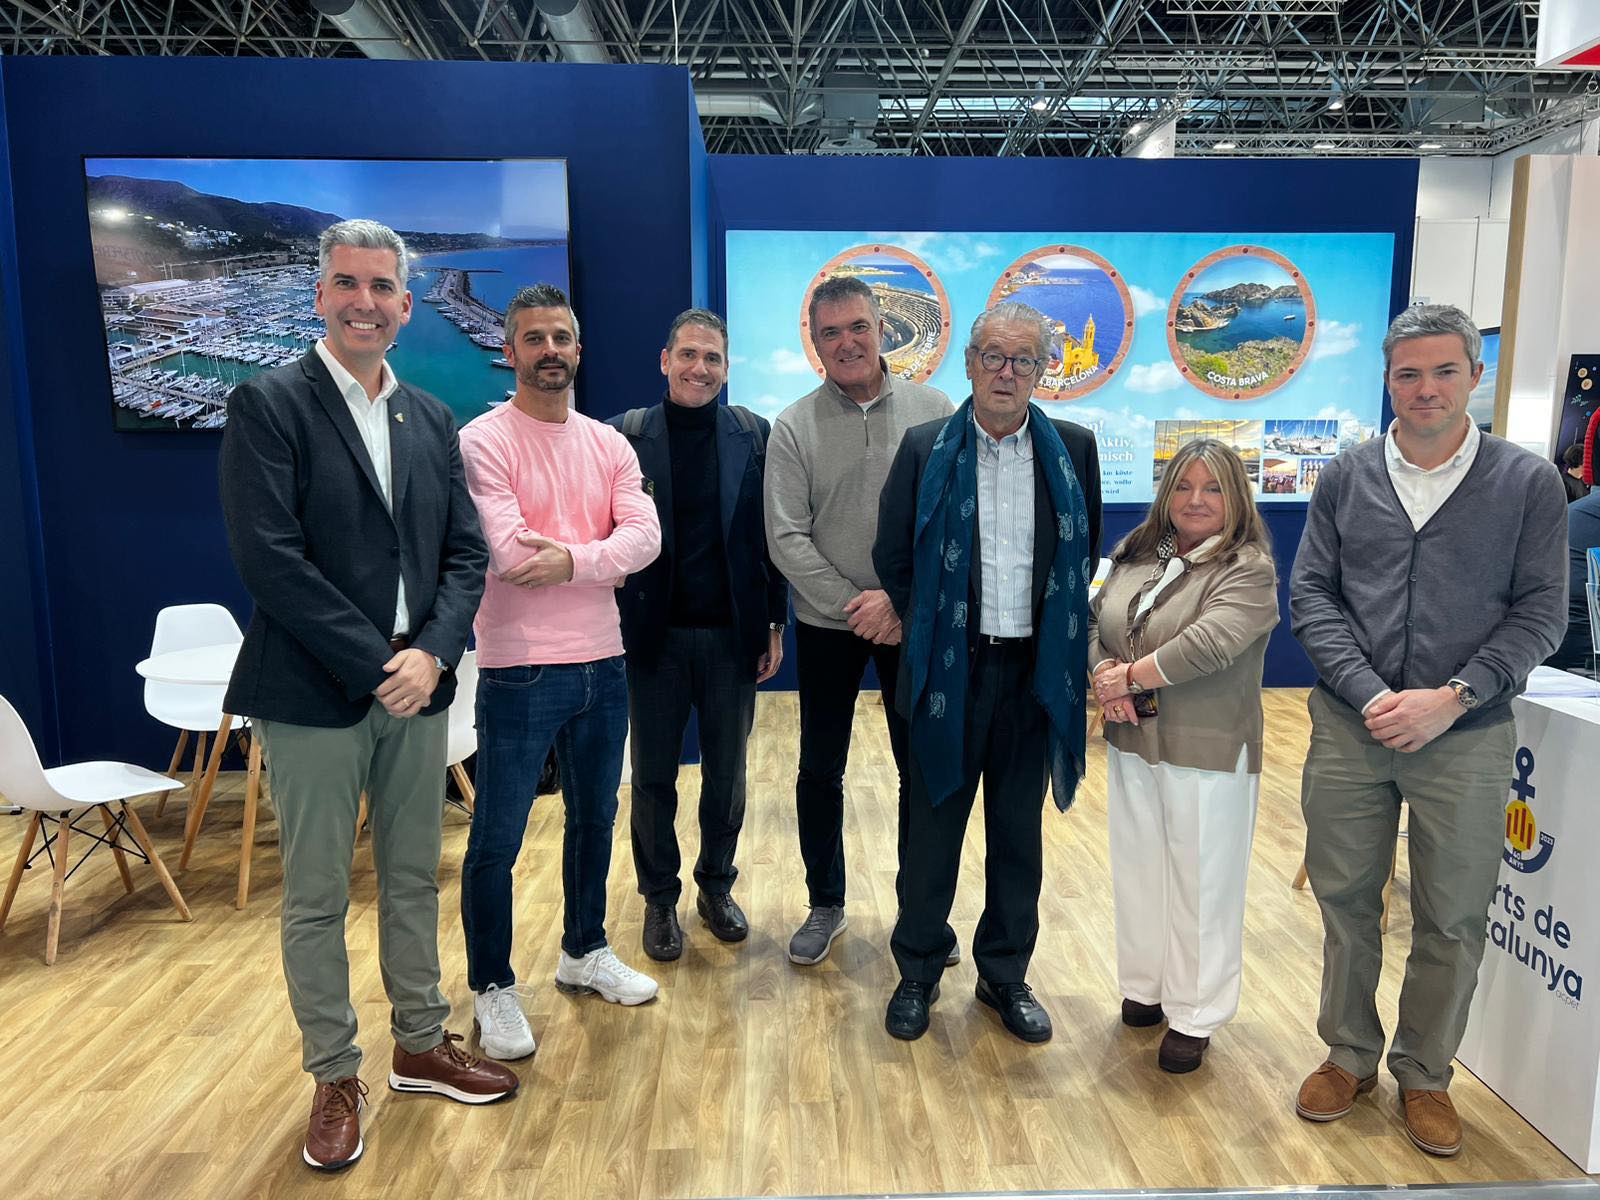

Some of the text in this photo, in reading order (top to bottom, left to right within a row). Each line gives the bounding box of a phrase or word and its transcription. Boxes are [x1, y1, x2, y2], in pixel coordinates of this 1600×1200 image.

[1046, 365, 1099, 387] BARCELONA
[1207, 371, 1269, 387] COSTA BRAVA
[1508, 857, 1524, 870] ANYS
[1534, 905, 1571, 949] de
